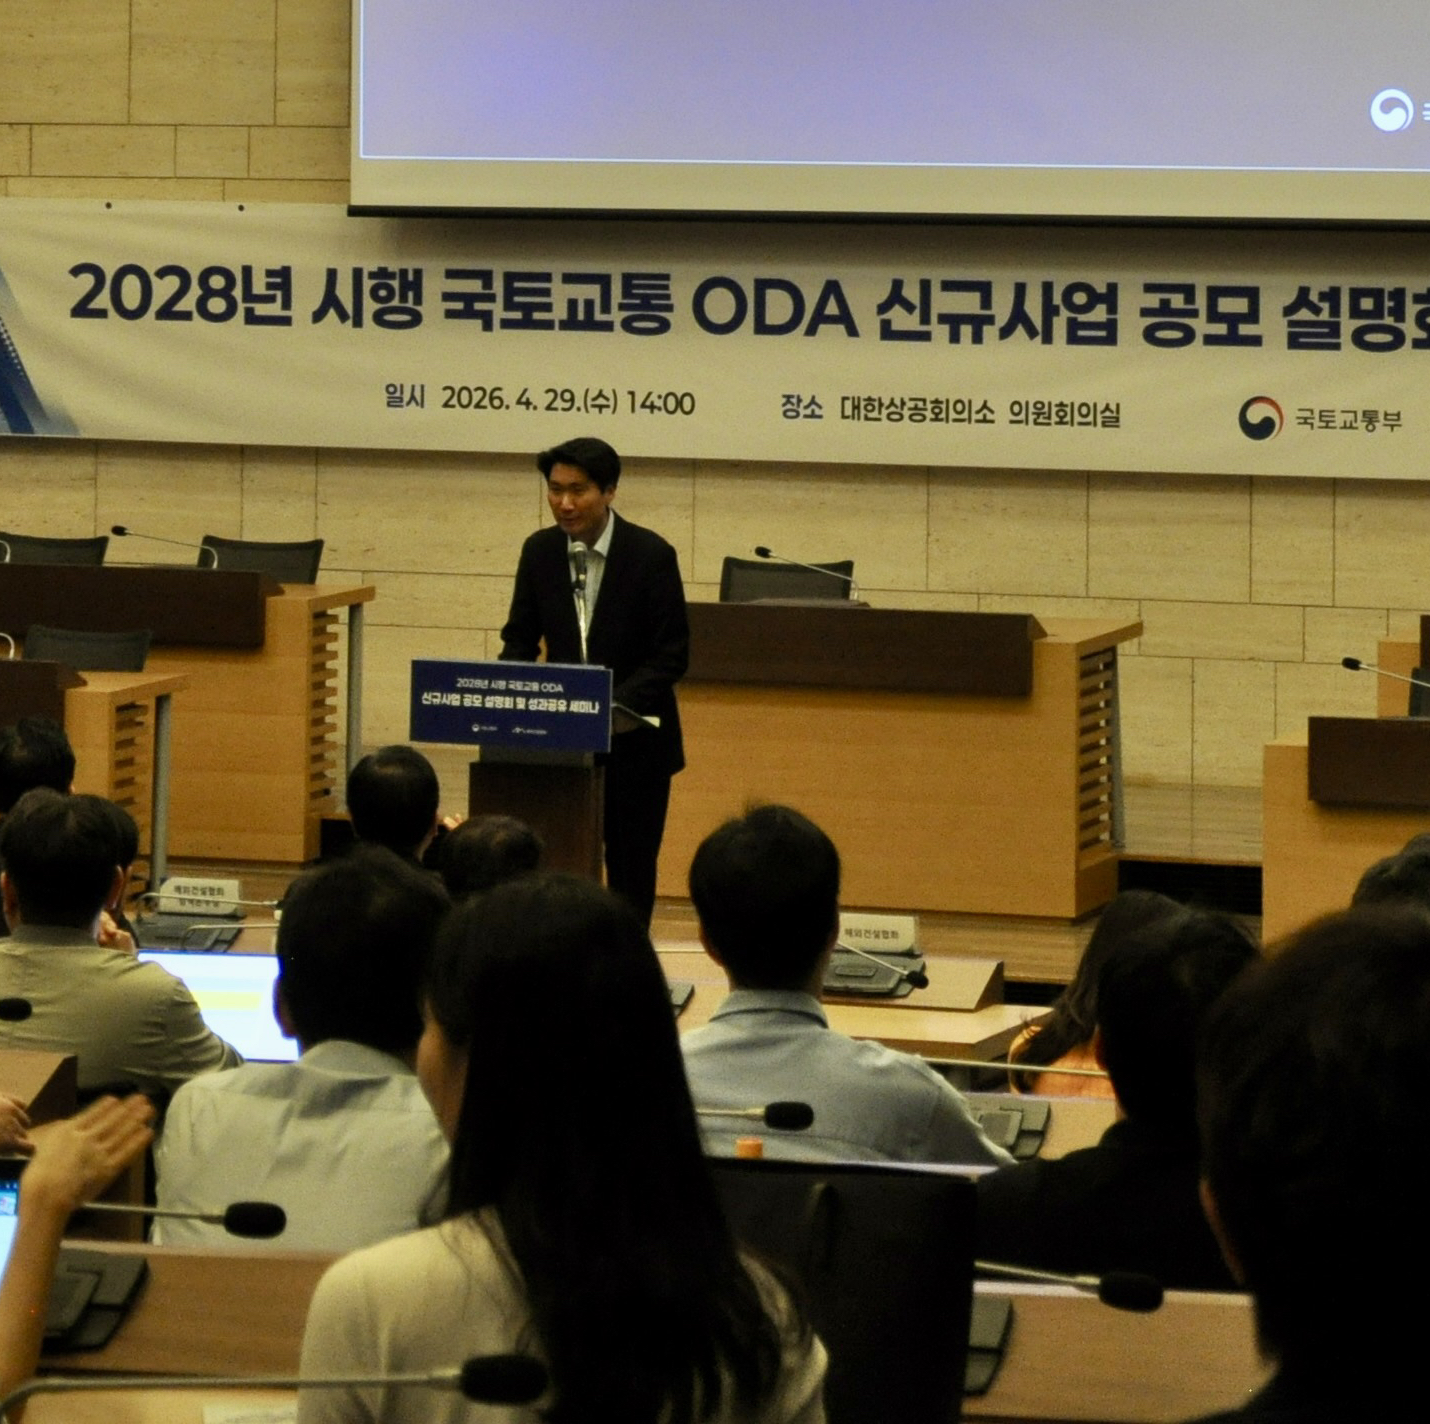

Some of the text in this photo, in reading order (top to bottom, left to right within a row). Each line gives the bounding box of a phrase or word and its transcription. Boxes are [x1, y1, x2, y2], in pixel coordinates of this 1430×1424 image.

[68, 262, 293, 327] 2028년
[311, 266, 423, 330] 시행
[441, 268, 674, 336] 국토교통
[692, 276, 859, 337] ODA
[877, 278, 1118, 346] 신규사업
[1139, 283, 1263, 348] 공모
[385, 383, 695, 416] 일시 2026. 4. 29.(수) 14:00
[781, 394, 1121, 428] 장소 대한상공회의소 의원회의실
[1295, 408, 1403, 433] 국토교통부
[456, 678, 489, 690] 2028년
[541, 683, 564, 693] ODA
[422, 692, 599, 714] 신규사업 공모 설명회 및 성과공유 세미나
